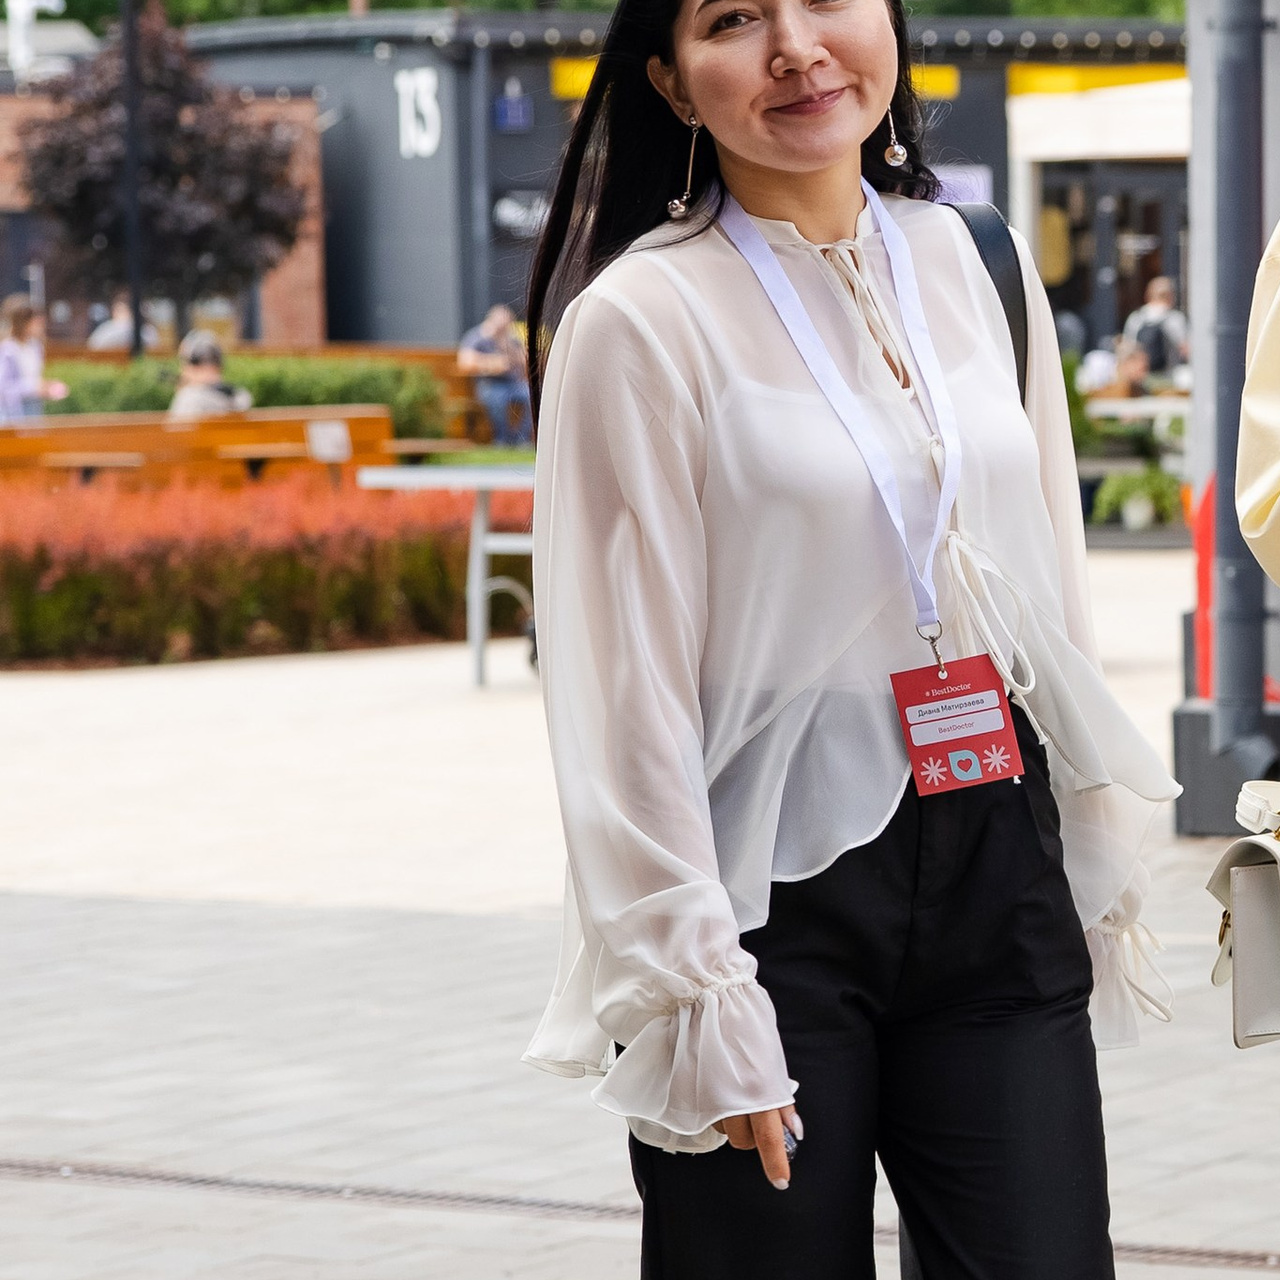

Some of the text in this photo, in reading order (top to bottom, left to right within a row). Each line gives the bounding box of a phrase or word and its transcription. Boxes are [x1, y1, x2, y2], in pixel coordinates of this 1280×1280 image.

[931, 683, 971, 696] BestDoctor
[918, 707, 940, 717] Диана
[938, 722, 974, 733] BestDoctor
